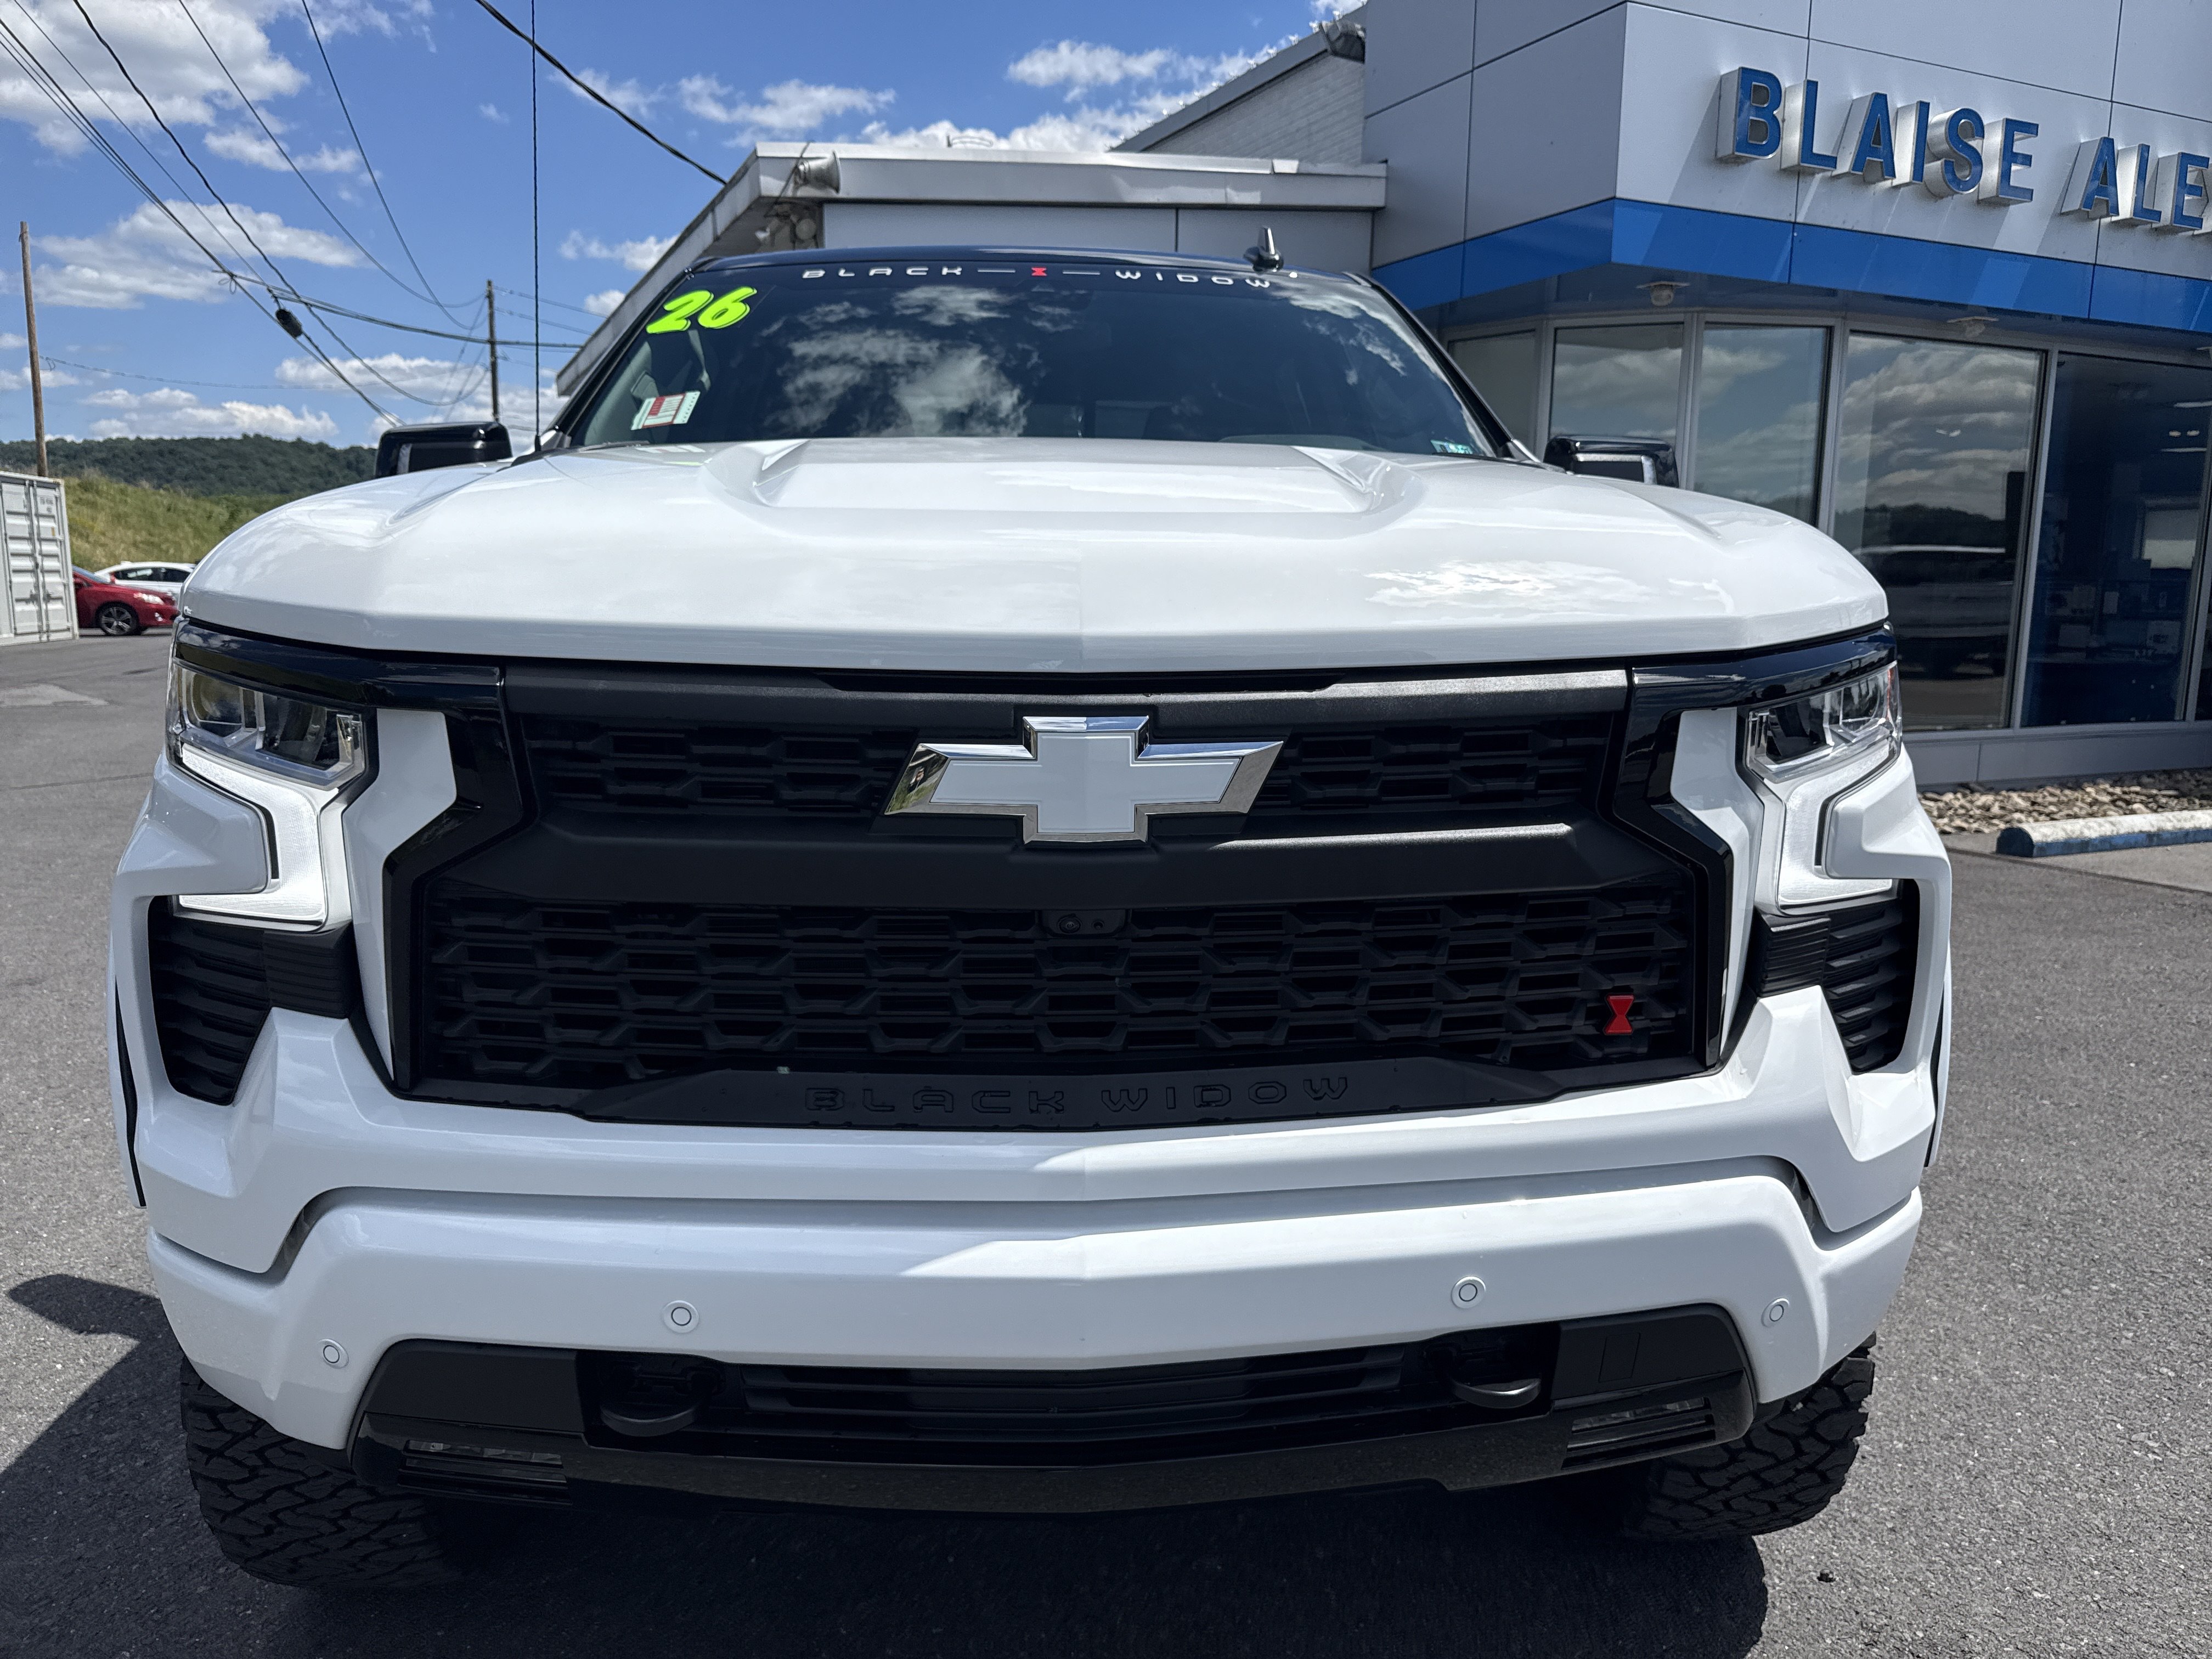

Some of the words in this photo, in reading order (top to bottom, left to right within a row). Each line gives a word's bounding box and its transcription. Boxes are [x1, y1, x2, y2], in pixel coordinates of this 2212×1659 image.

[1734, 66, 2039, 202] BLAISE
[802, 266, 962, 279] BLACK
[1115, 269, 1271, 289] WIDOW
[645, 286, 758, 334] 26
[805, 1087, 1065, 1114] BLACK
[1101, 1076, 1348, 1113] WIDOW
